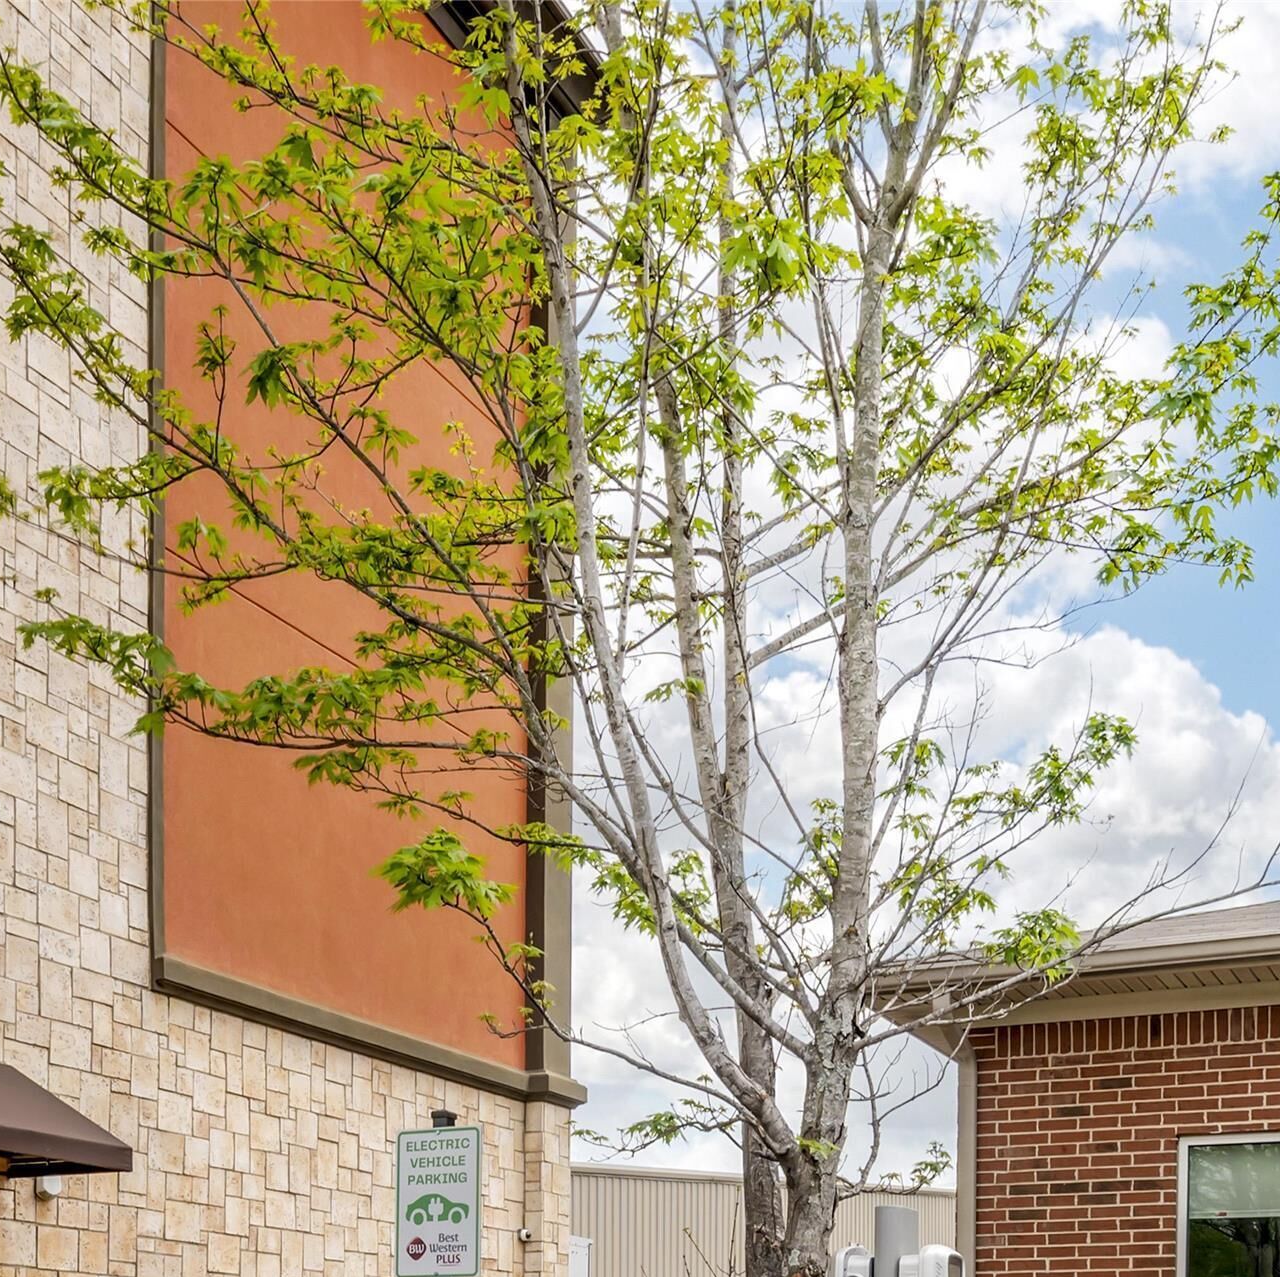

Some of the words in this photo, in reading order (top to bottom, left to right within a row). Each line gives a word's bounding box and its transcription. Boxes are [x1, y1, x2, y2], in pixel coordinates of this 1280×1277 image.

[406, 1137, 470, 1152] ELECTRIC
[410, 1155, 466, 1169] VEHICLE
[407, 1172, 468, 1186] PARKING
[438, 1232, 459, 1243] Best
[408, 1243, 425, 1254] BW
[429, 1243, 468, 1253] Western
[436, 1254, 461, 1264] PLUS
